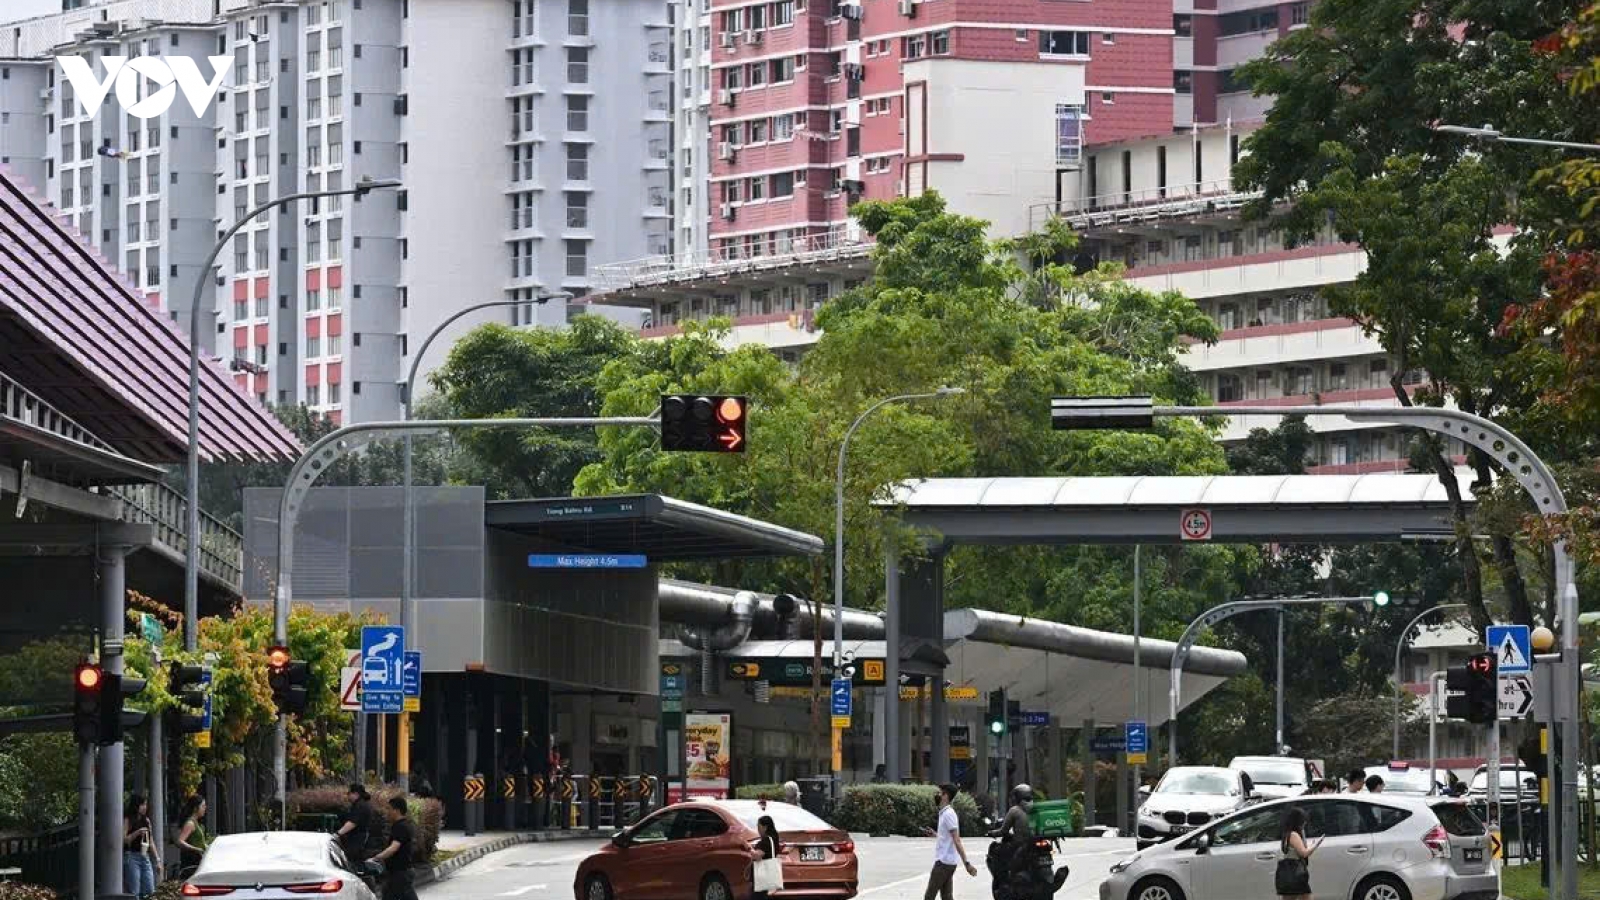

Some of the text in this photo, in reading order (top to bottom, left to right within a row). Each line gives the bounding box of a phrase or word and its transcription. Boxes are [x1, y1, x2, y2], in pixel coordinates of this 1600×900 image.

[557, 556, 618, 567] Max Height 4.5m
[1499, 700, 1514, 710] hru
[686, 727, 717, 736] eryday
[1045, 815, 1066, 827] Grab
